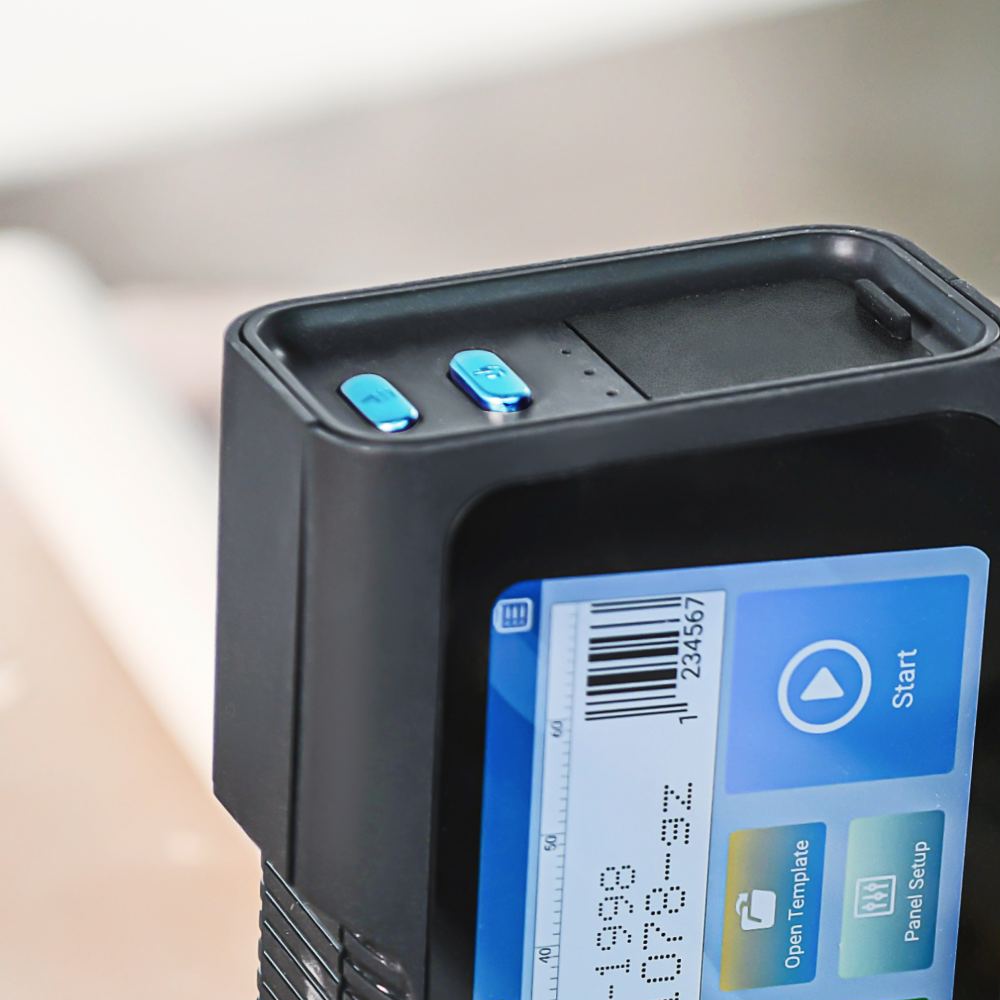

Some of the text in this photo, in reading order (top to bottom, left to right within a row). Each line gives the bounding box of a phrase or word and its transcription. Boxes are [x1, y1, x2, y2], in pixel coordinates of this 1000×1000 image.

[681, 596, 705, 679] 234567
[892, 649, 917, 708] Start
[544, 834, 557, 851] 50
[785, 839, 810, 969] Open Template
[904, 841, 931, 942] Panel Setup
[538, 947, 551, 963] 40
